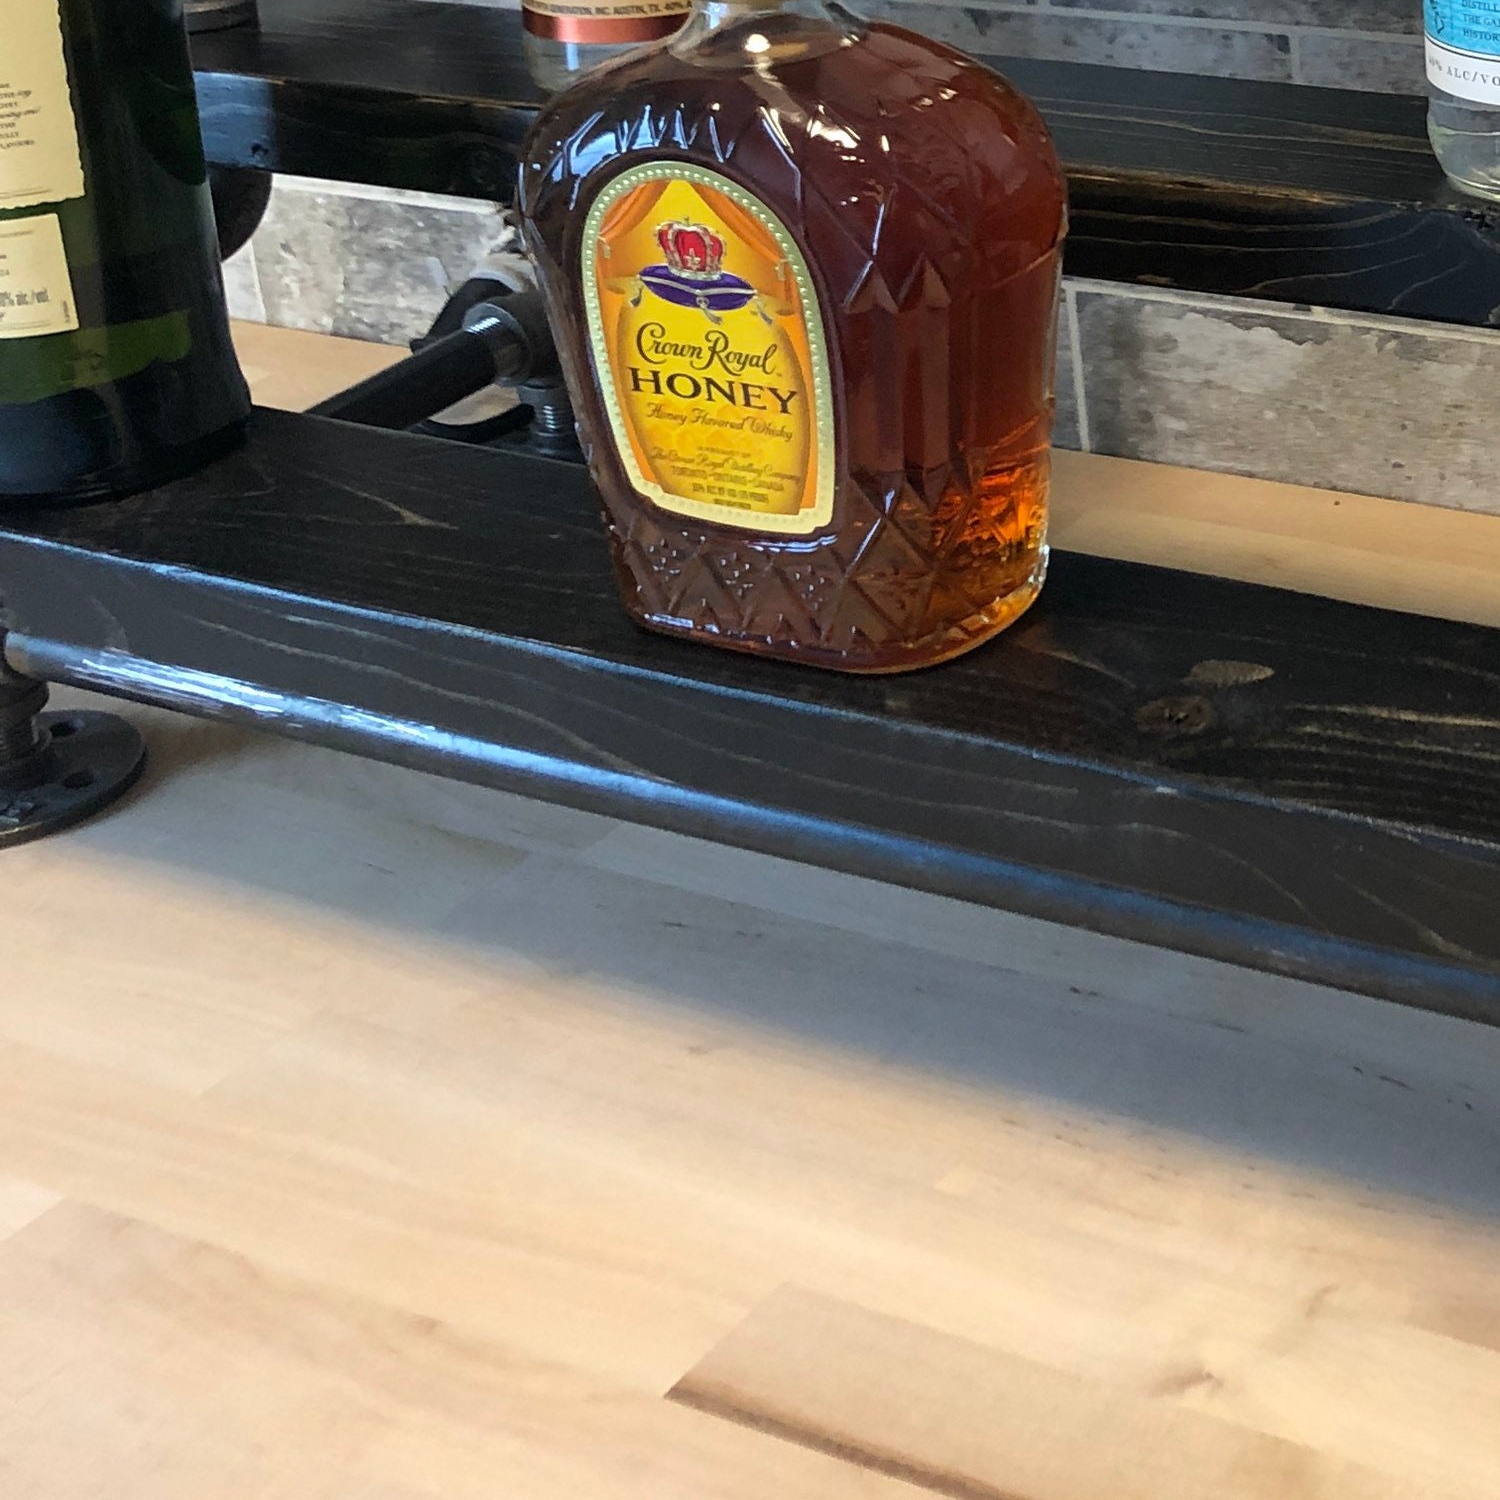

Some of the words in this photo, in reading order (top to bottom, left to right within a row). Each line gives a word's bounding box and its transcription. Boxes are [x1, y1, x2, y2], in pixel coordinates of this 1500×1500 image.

[1462, 13, 1482, 26] THE
[635, 320, 704, 366] Crown
[689, 329, 779, 377] Royal
[628, 366, 800, 416] HONEY
[646, 401, 689, 427] Honey
[690, 407, 748, 432] Flavored
[748, 415, 794, 443] Whisky
